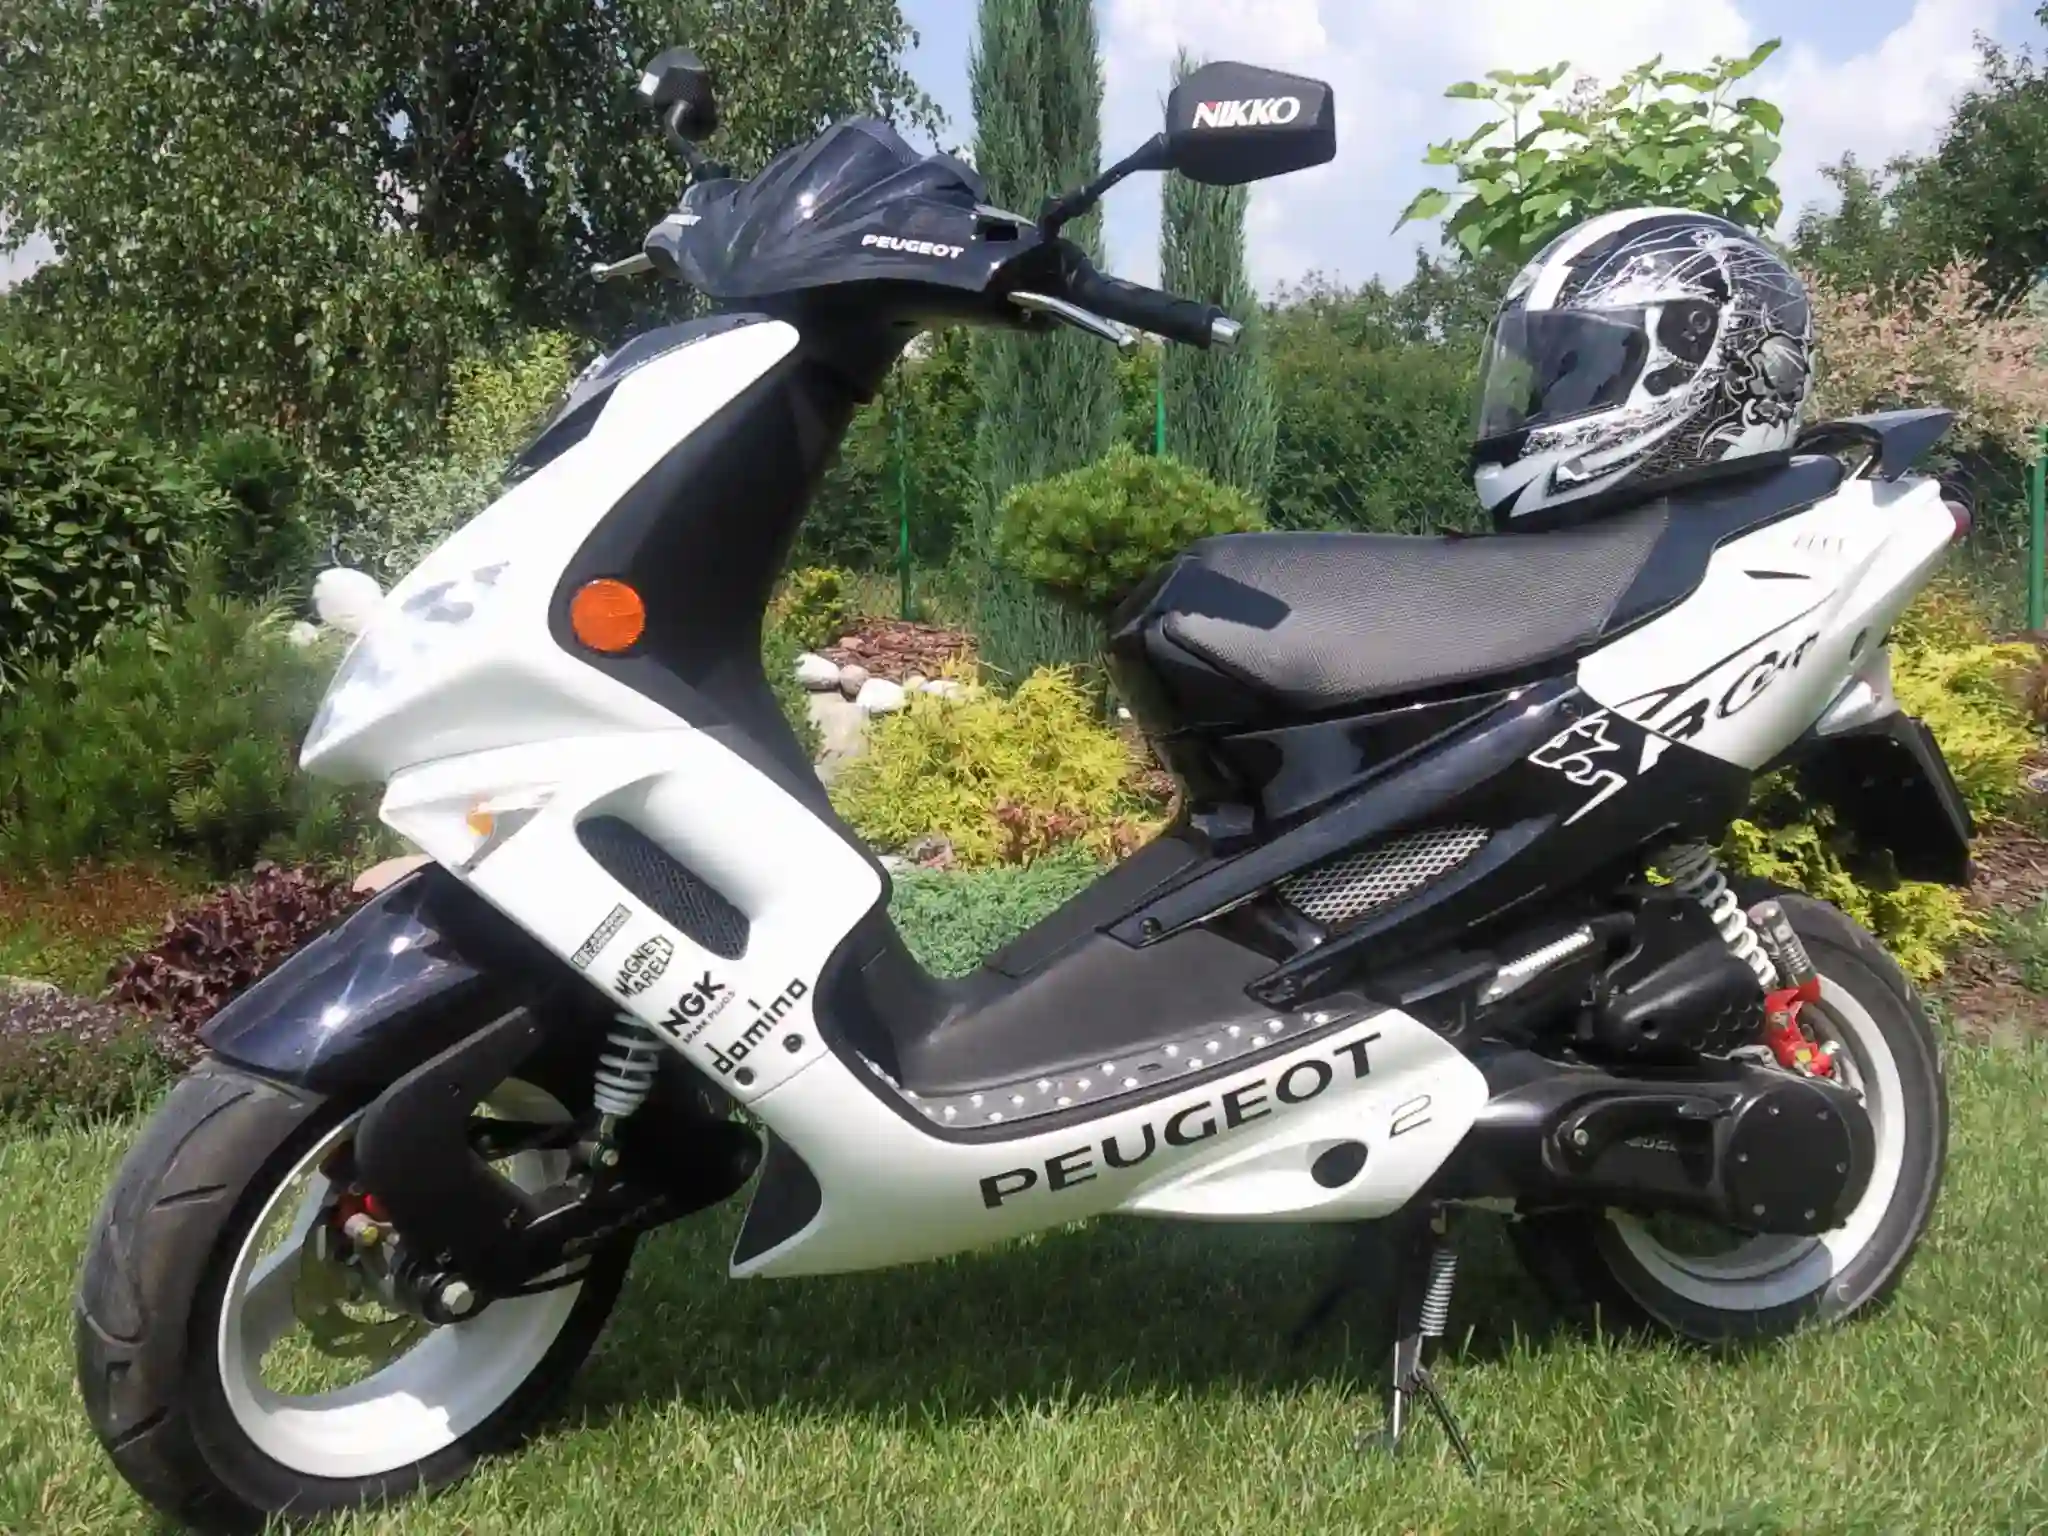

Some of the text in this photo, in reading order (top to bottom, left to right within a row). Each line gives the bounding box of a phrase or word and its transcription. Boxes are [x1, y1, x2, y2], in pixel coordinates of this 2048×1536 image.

[1192, 96, 1300, 129] NIKKO
[861, 234, 964, 259] PEUGEOT
[660, 971, 725, 1037] NGK
[704, 978, 808, 1075] domino
[979, 1032, 1381, 1210] PEUGEOT
[1389, 1094, 1432, 1139] 2
